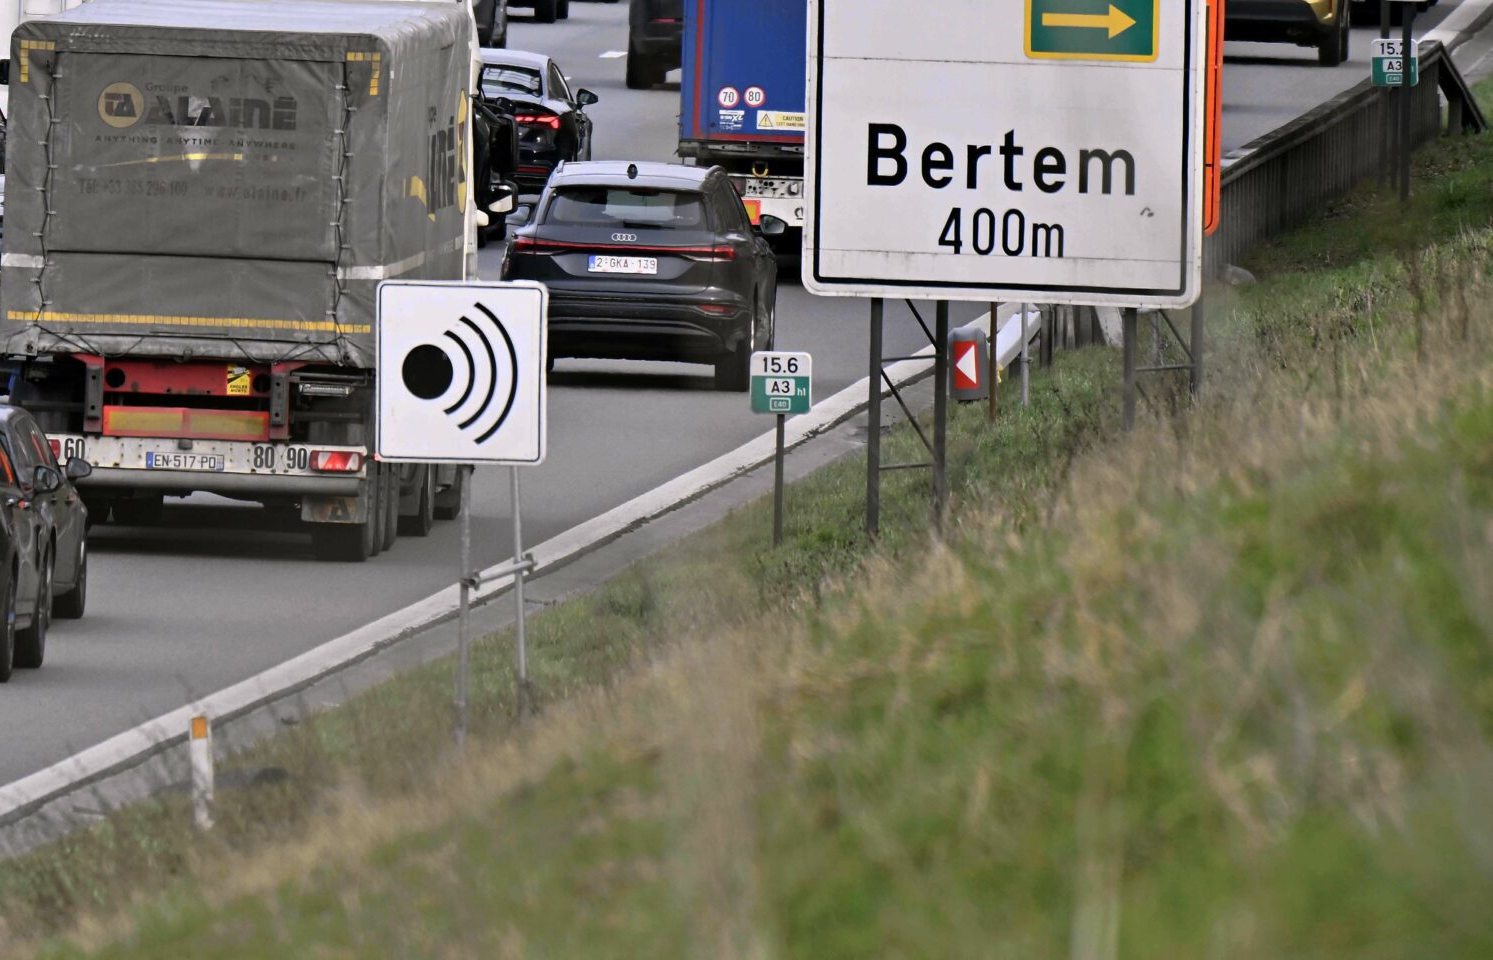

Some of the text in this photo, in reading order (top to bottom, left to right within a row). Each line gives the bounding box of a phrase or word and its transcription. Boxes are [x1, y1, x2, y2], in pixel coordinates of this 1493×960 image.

[1386, 60, 1403, 71] A3
[145, 81, 189, 93] Groupe
[722, 91, 735, 103] 70
[748, 90, 761, 102] 80
[94, 134, 158, 145] ANYTHING
[228, 139, 297, 151] ANYWHERE
[867, 123, 1136, 197] Bertem
[937, 207, 1065, 259] 400m
[596, 257, 656, 271] 2-GKA-139
[762, 356, 799, 374] 15.6
[770, 380, 790, 394] A3
[64, 437, 86, 461] 60
[253, 446, 307, 470] 80 90
